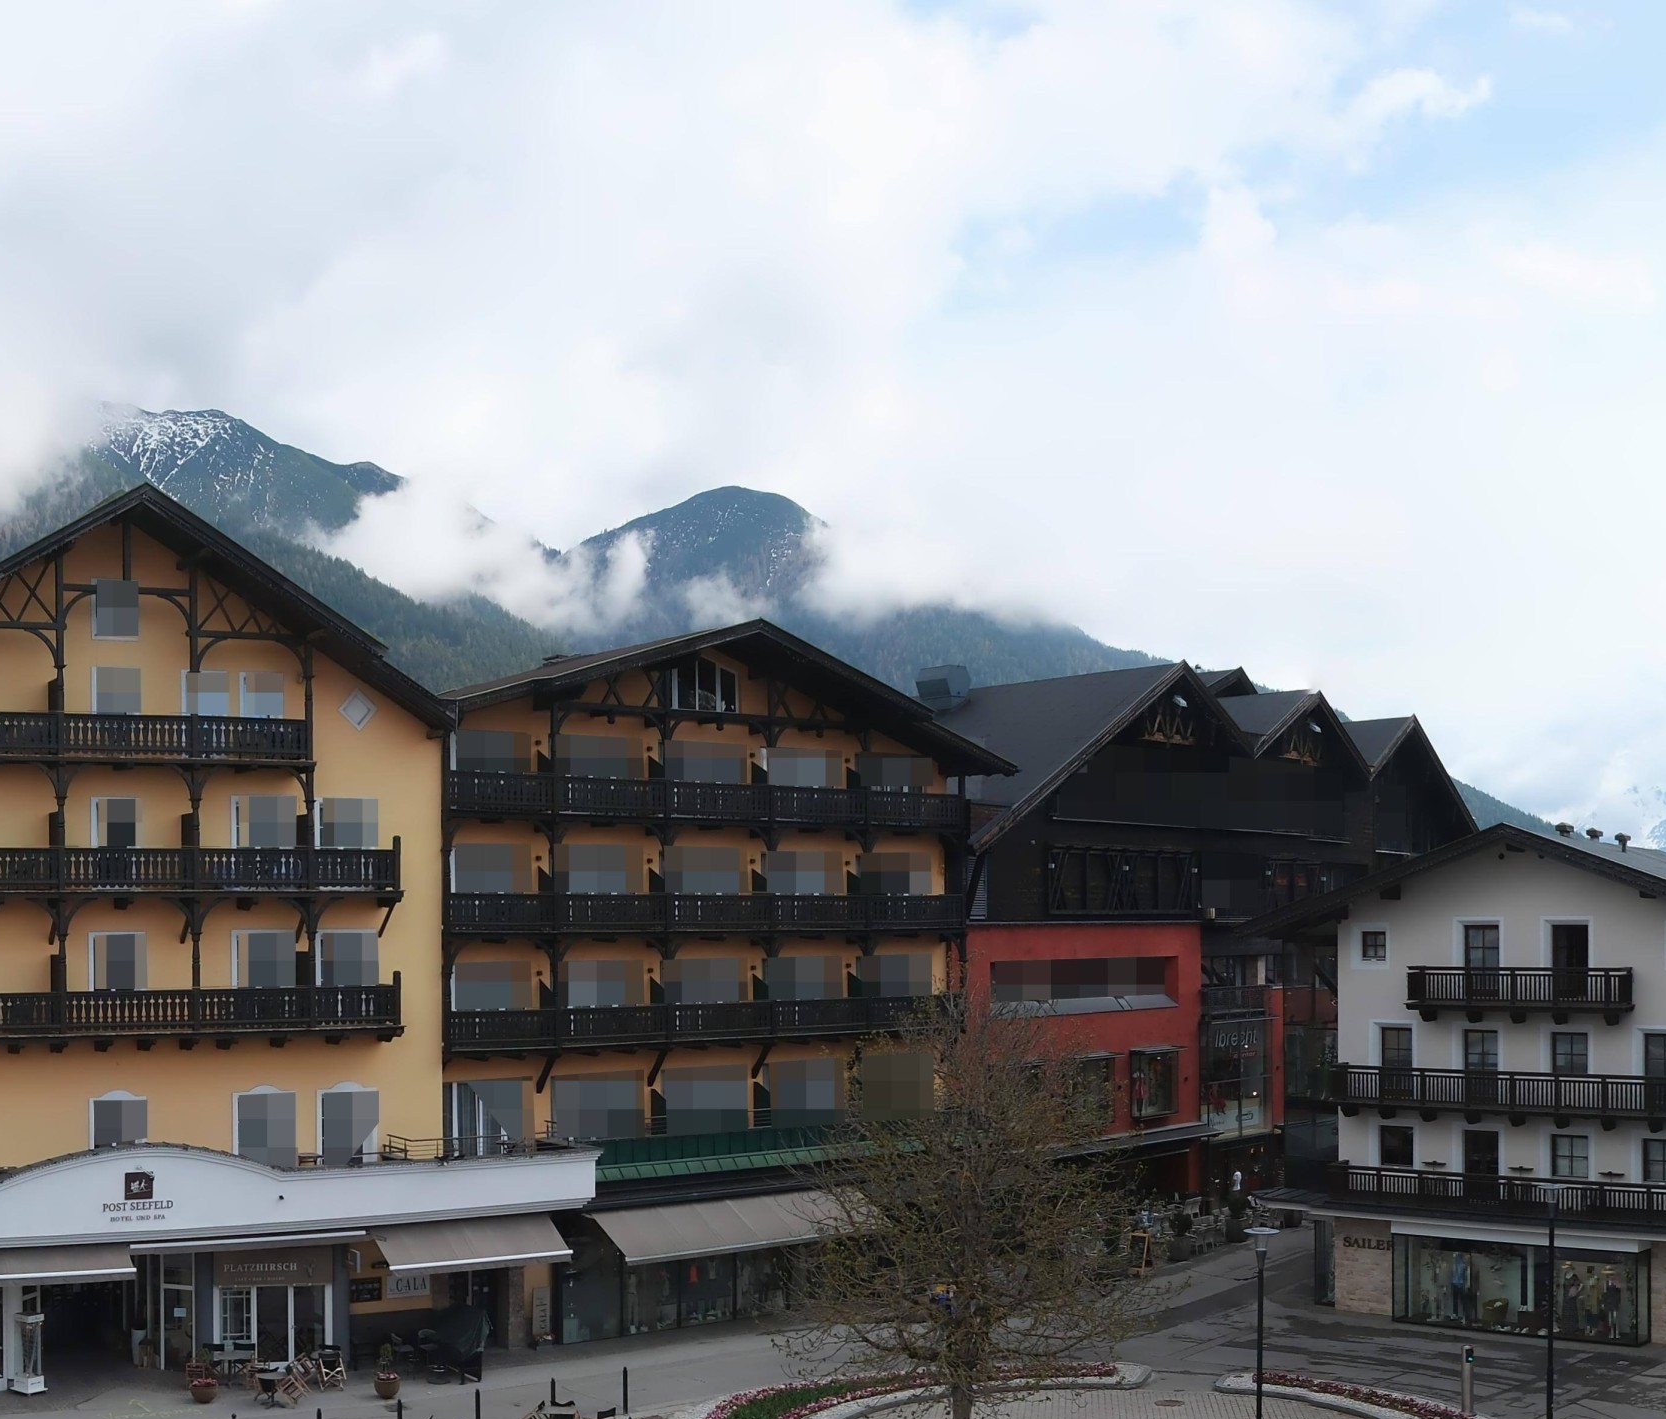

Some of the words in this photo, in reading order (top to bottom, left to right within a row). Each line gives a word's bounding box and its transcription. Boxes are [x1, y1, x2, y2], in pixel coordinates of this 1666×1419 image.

[103, 1203, 128, 1213] POST
[129, 1200, 174, 1211] SEEFELD
[223, 1262, 297, 1272] PLATZHIRSCH
